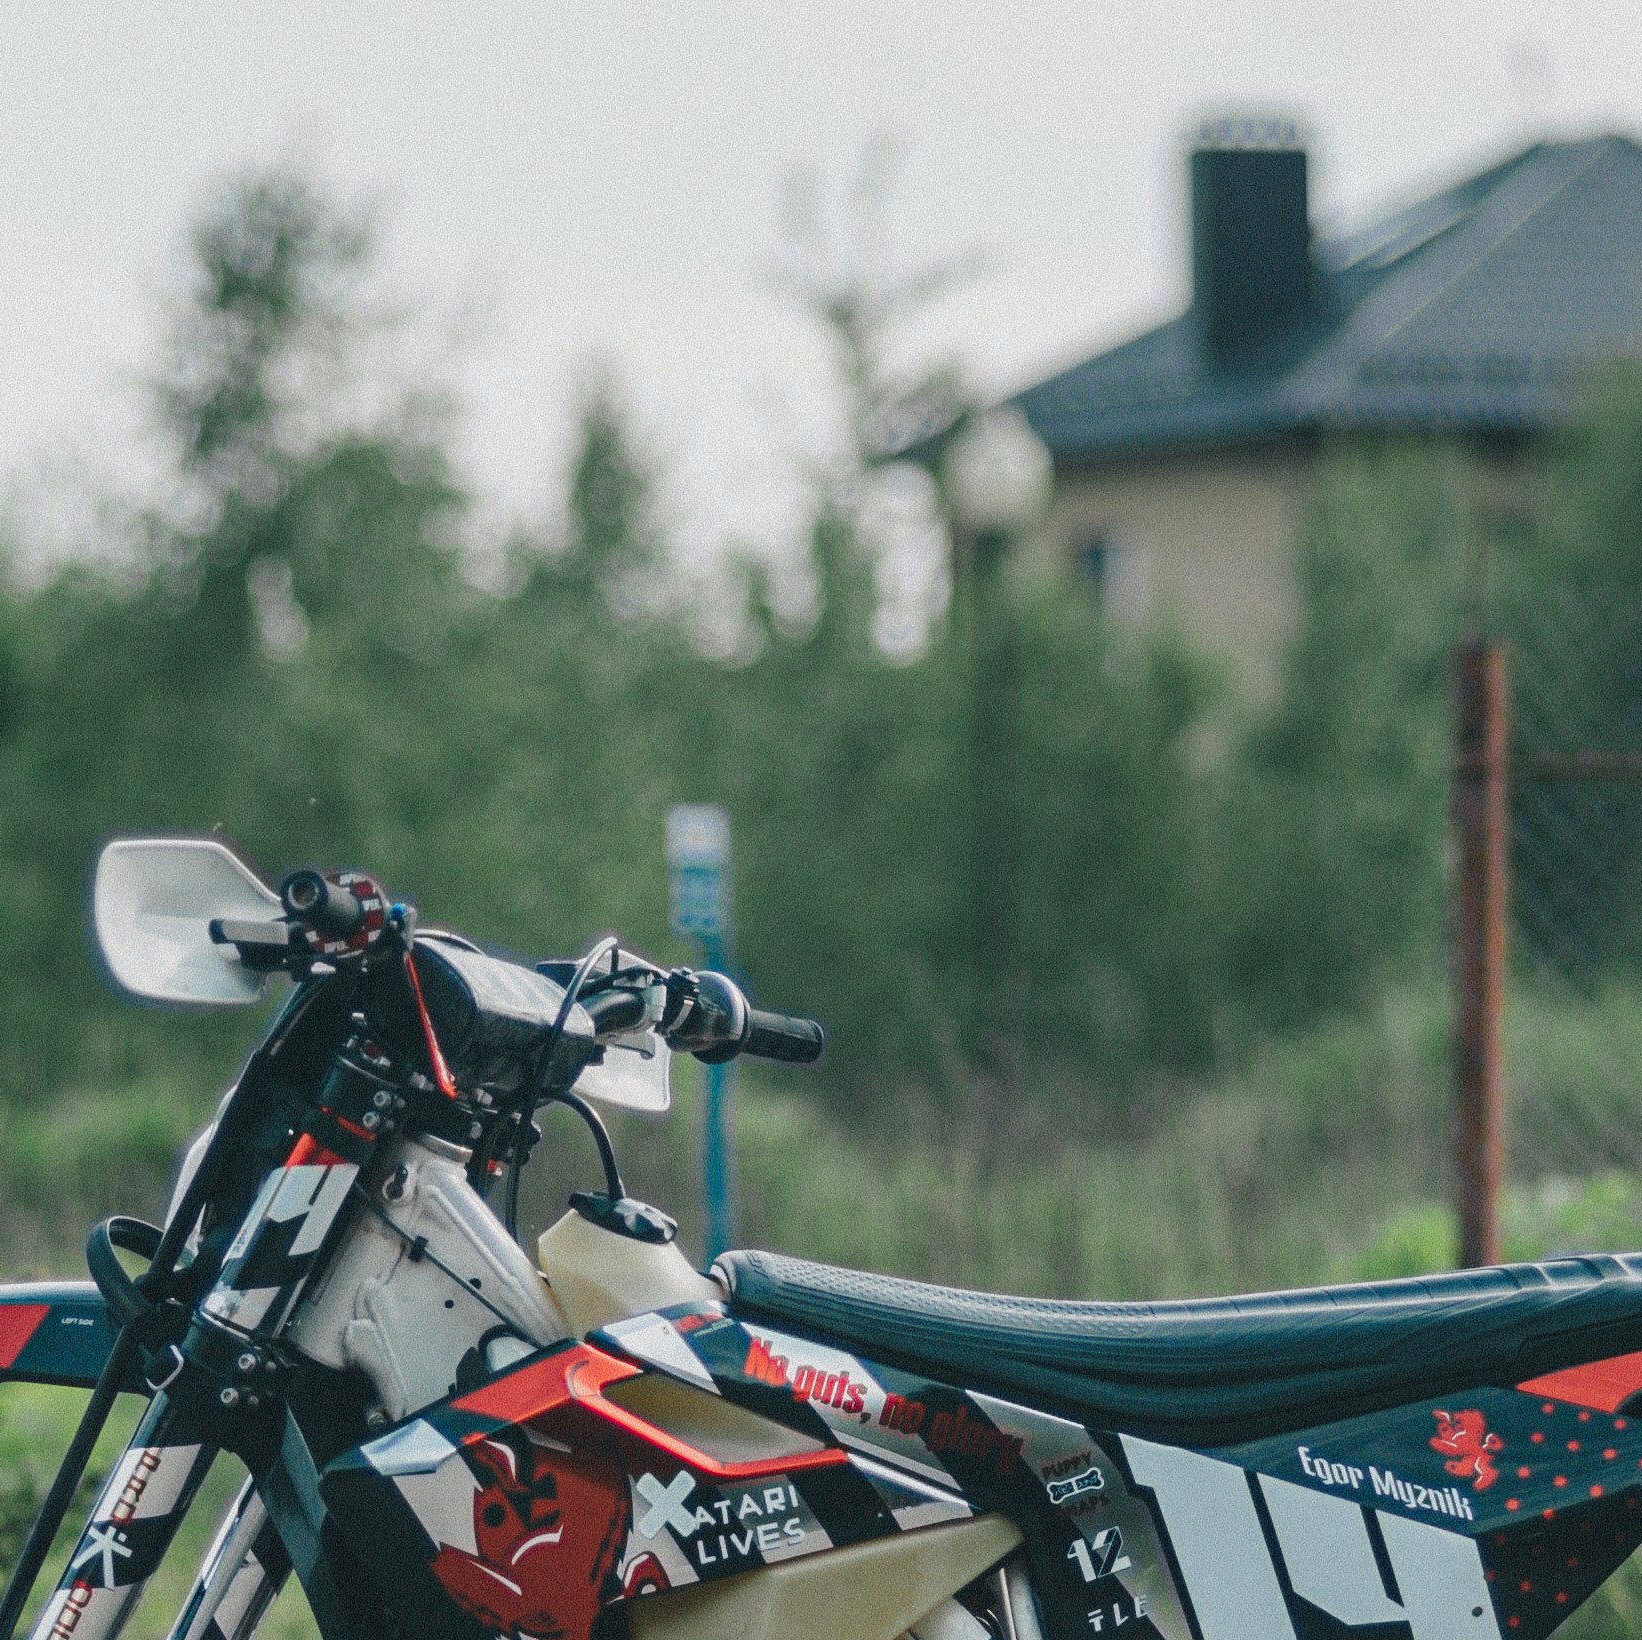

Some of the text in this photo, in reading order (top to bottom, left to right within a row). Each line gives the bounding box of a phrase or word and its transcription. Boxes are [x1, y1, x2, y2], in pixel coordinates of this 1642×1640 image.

[743, 1336, 789, 1388] No
[790, 1364, 872, 1424] guts,
[878, 1391, 927, 1435] no
[1297, 1446, 1474, 1521] Egor Myznik
[696, 1517, 806, 1565] LIVES
[1066, 1525, 1132, 1583] 12
